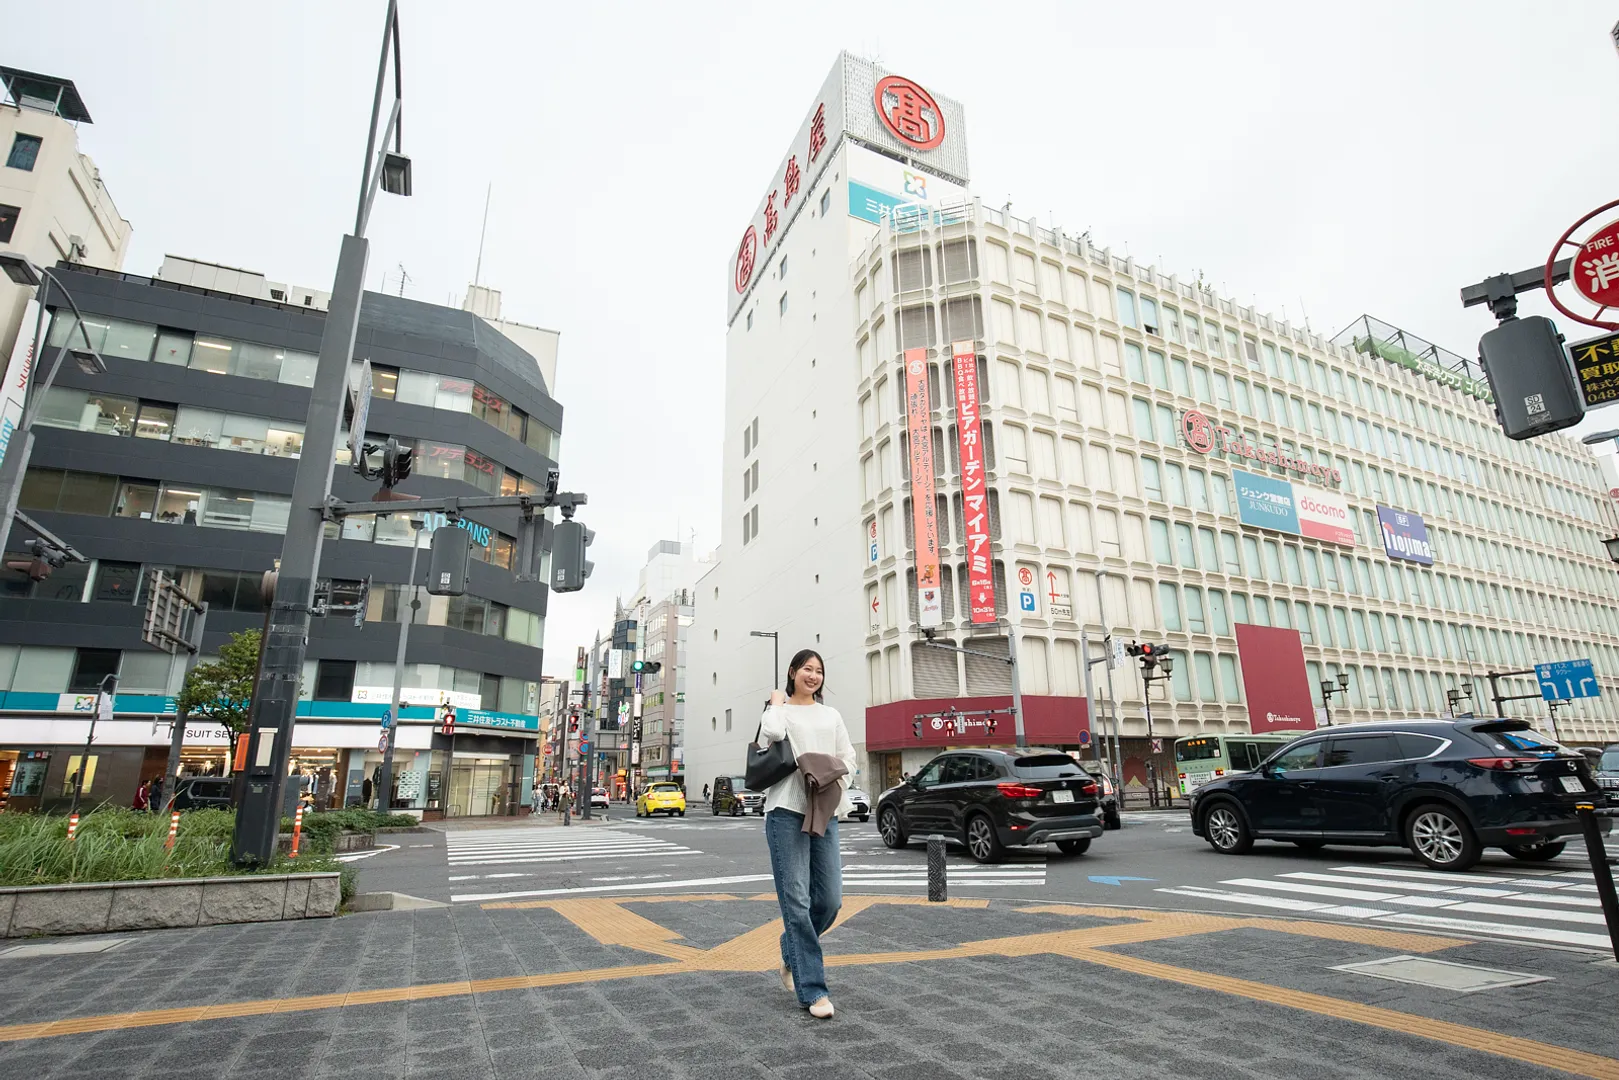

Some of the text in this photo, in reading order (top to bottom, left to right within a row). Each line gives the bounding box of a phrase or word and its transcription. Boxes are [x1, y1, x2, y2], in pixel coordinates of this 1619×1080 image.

[1586, 235, 1614, 253] FIRE
[1215, 426, 1342, 487] Takashimaya
[1249, 500, 1288, 517] JUNKUDO
[1300, 496, 1345, 520] docomo
[467, 714, 526, 728] 三井住友トラスト不動産
[186, 730, 212, 738] SUIT
